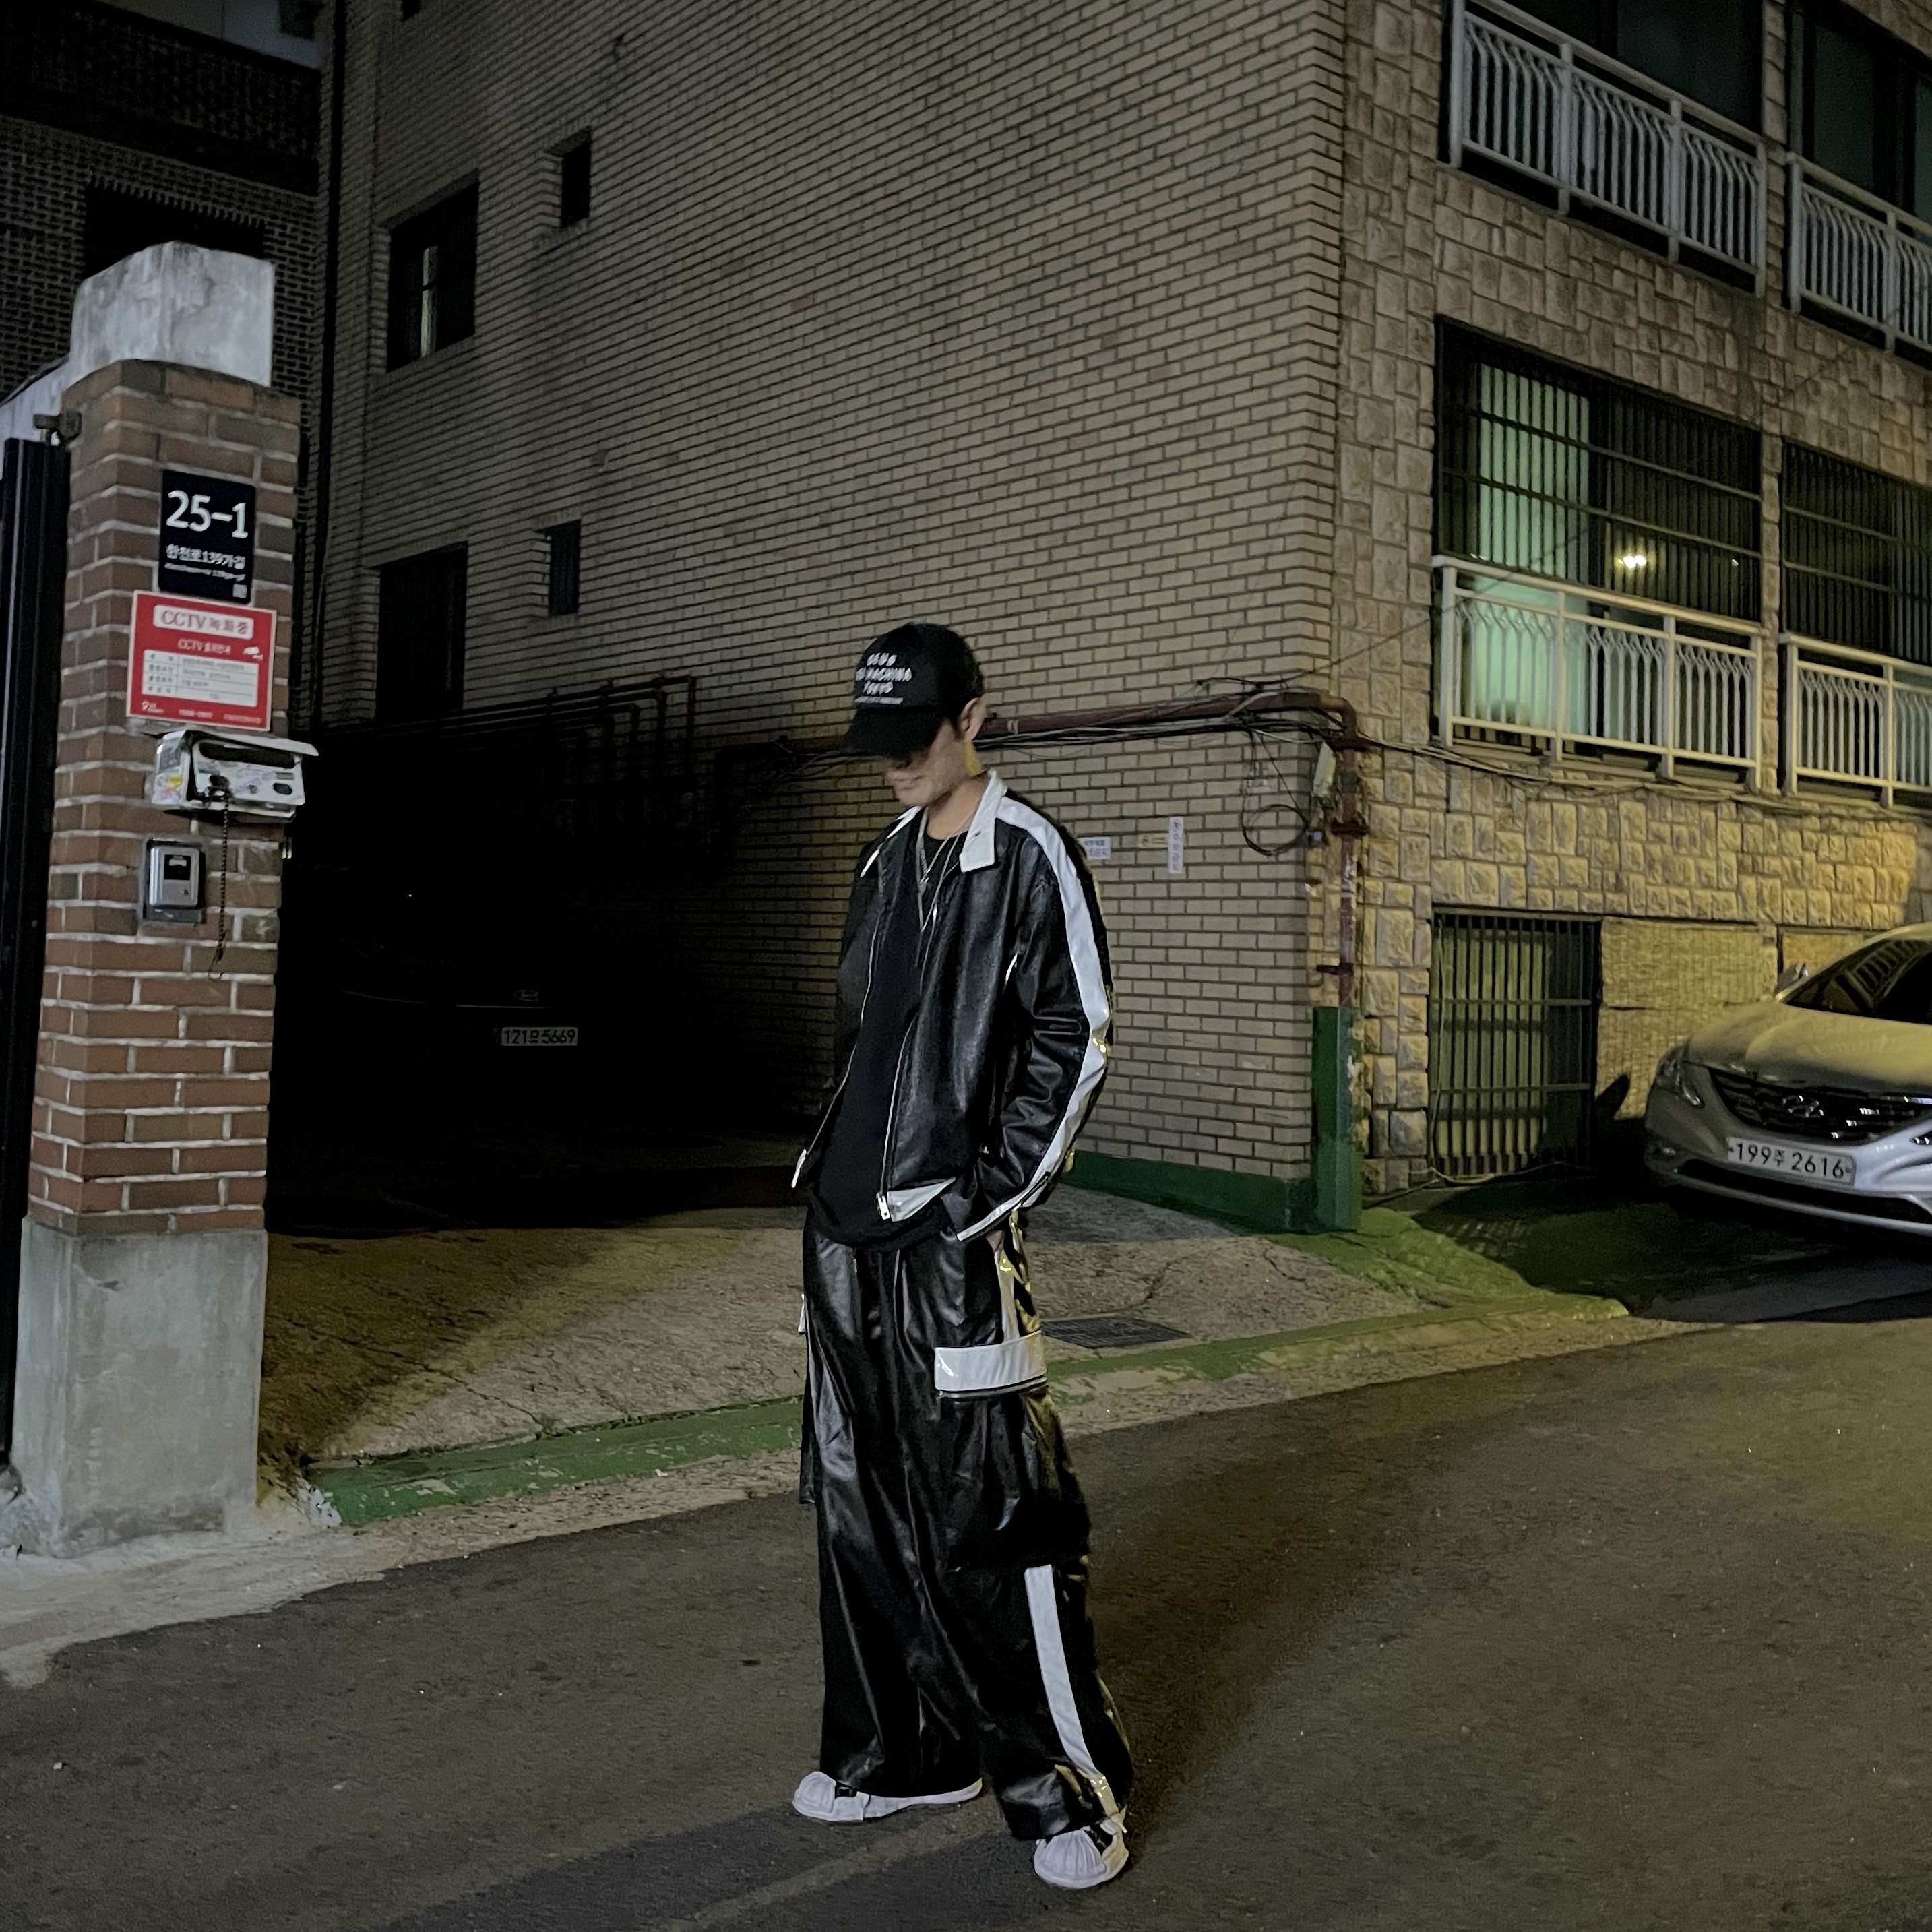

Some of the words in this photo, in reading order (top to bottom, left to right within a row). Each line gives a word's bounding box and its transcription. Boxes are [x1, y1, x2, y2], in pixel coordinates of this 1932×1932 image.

[166, 489, 249, 539] 25-1
[161, 609, 206, 629] CCTV
[1791, 1152, 1844, 1179] 2616
